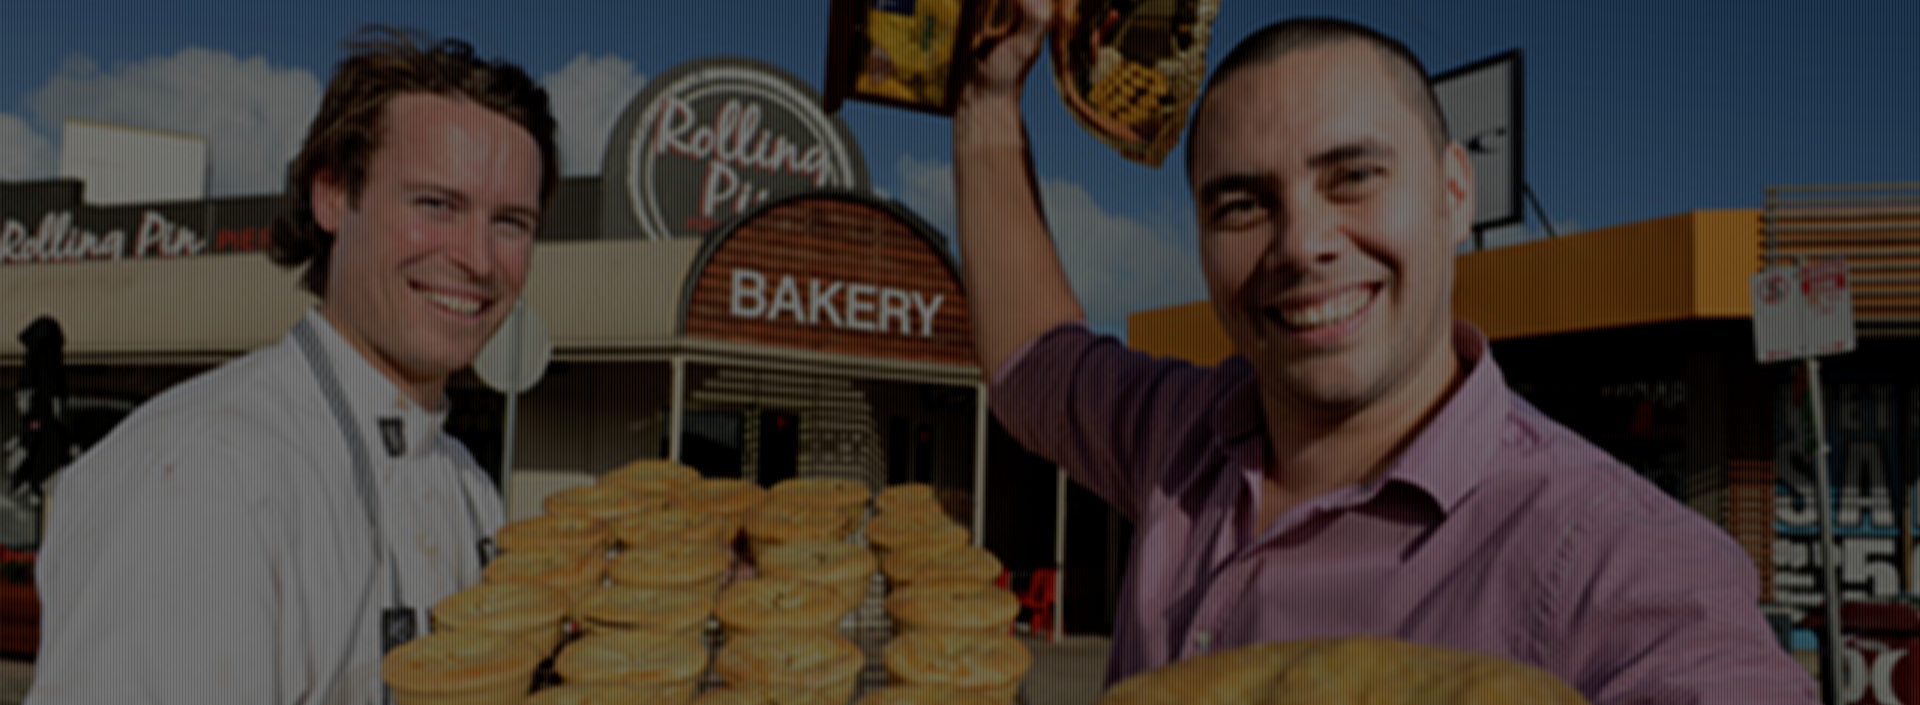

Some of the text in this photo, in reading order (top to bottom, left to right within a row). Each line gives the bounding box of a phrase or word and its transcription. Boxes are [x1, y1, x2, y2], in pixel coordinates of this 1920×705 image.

[655, 98, 834, 189] Rolling
[0, 210, 126, 264] Rolling
[132, 209, 207, 259] Pin
[730, 268, 946, 339] BAKERY
[1774, 439, 1920, 532] SA
